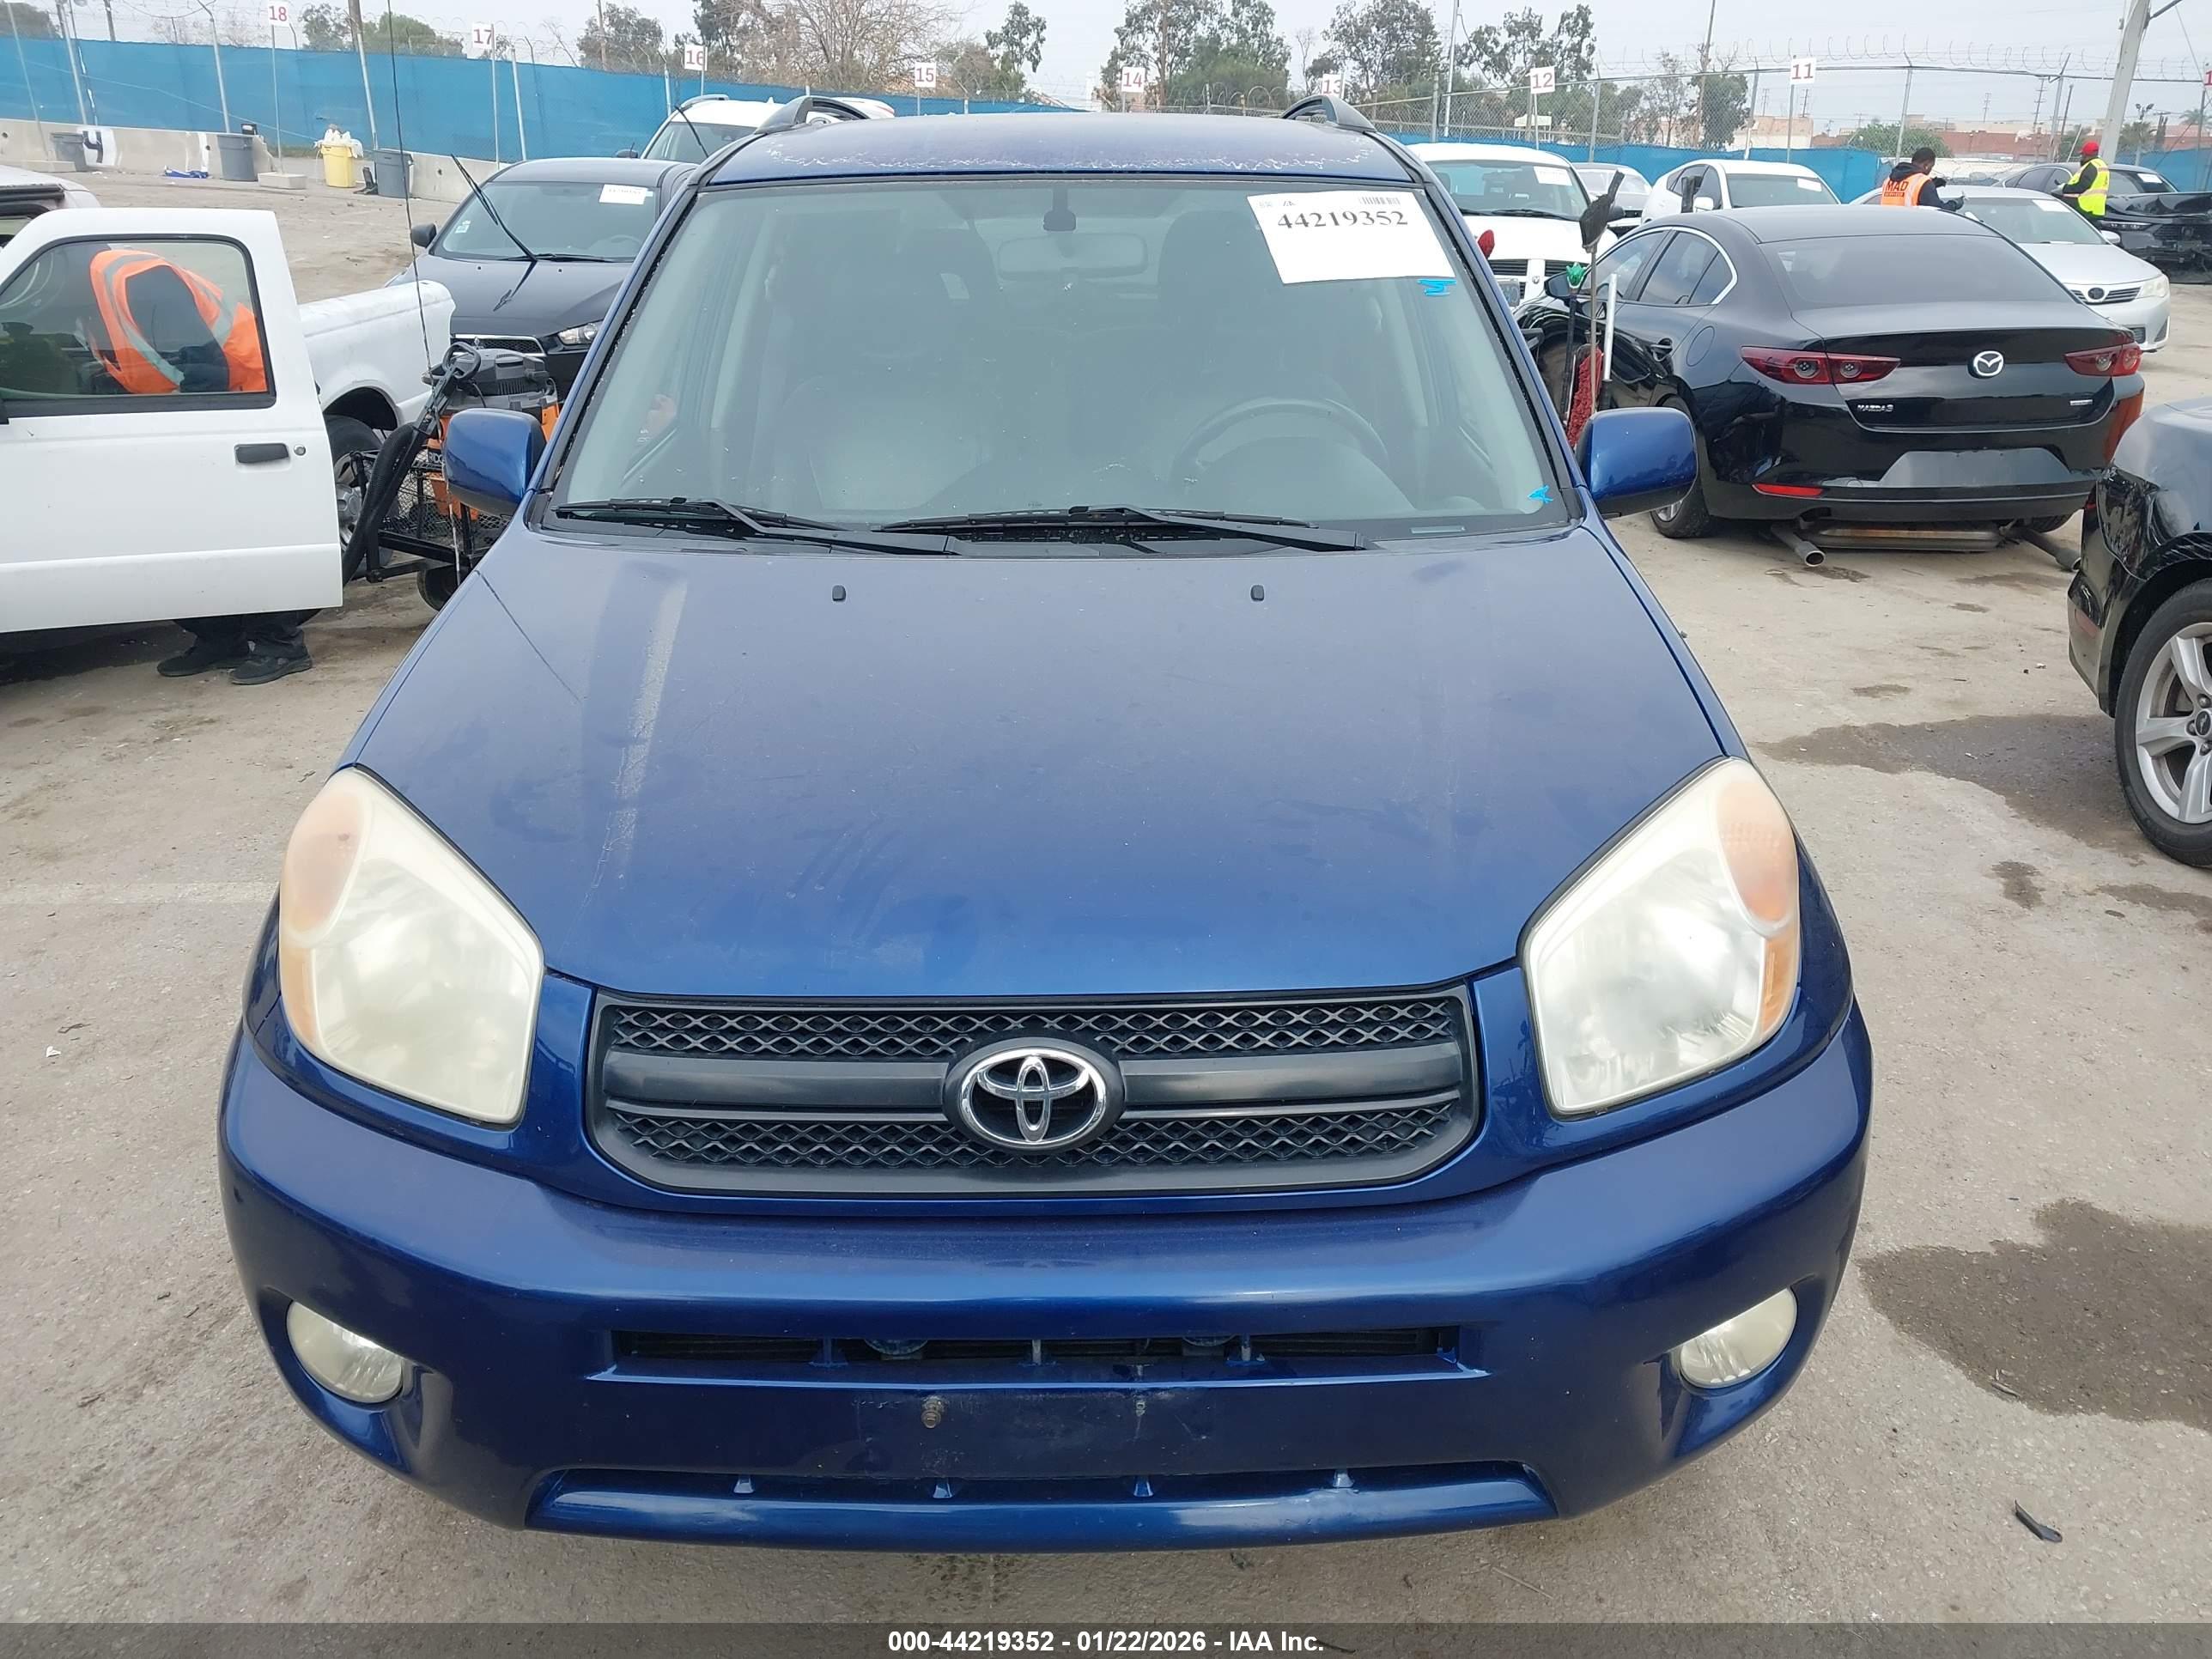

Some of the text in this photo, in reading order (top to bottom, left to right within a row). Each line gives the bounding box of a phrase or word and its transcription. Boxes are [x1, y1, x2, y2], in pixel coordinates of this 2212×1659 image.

[269, 5, 288, 21] 18
[473, 28, 492, 45] 17
[686, 50, 704, 66] 16
[916, 67, 934, 82] 15
[1791, 63, 1814, 79] 11
[1122, 72, 1143, 88] 14
[1322, 79, 1340, 94] 13
[1532, 72, 1553, 89] 12
[1277, 210, 1408, 228] 44219352
